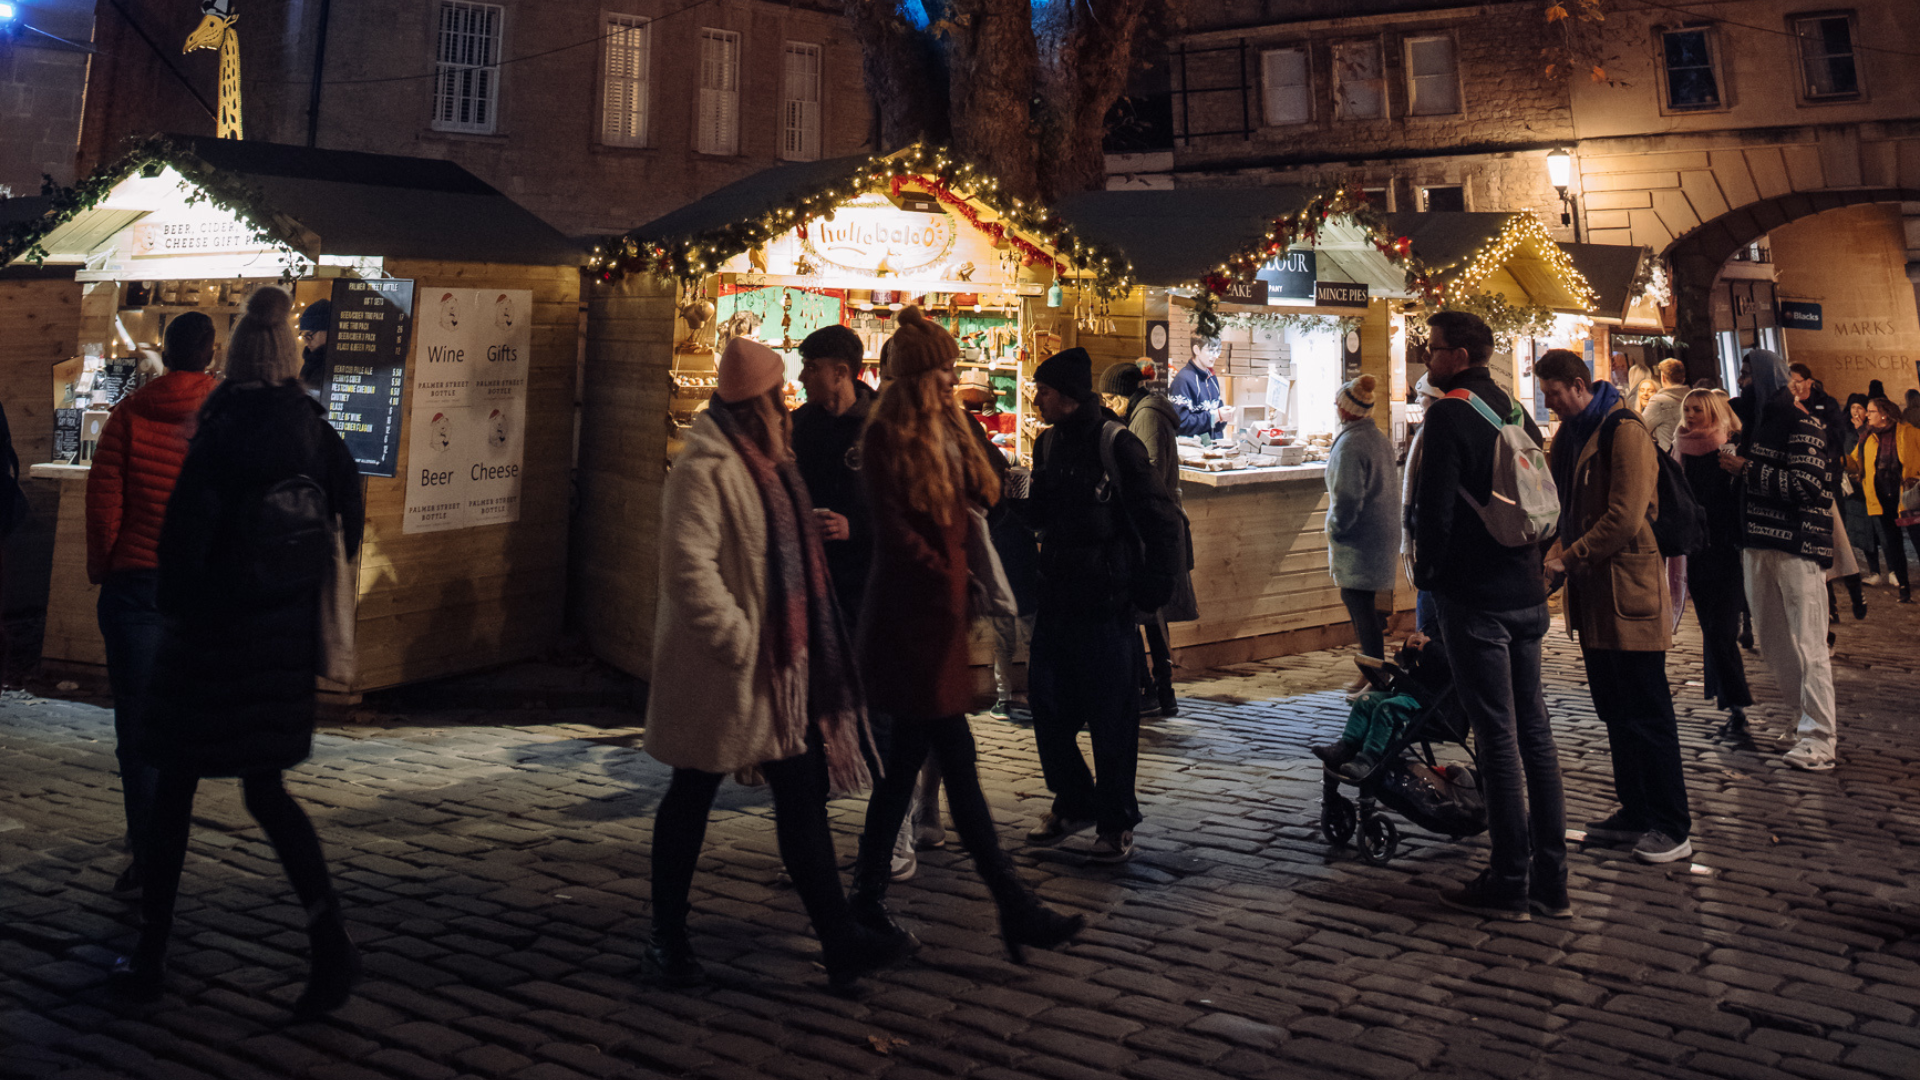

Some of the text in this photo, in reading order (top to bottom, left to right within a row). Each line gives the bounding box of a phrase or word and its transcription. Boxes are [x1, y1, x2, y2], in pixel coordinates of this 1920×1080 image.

[164, 222, 239, 235] BEER, CIDER,
[165, 237, 208, 249] CHEESE
[214, 236, 240, 247] GIFT
[349, 283, 366, 291] PALMER
[1318, 287, 1367, 302] MINCE PIES
[1793, 312, 1819, 321] Blacks
[1834, 321, 1895, 336] MARKS
[428, 345, 464, 363] Wine
[487, 344, 517, 362] Gifts
[1835, 355, 1913, 370] SPENCER
[418, 381, 443, 389] PALMER
[501, 379, 524, 387] STREET
[421, 469, 454, 486] Beer
[471, 462, 519, 481] Cheese
[436, 503, 461, 511] STREET
[469, 496, 517, 507] PALMER STREET
[481, 506, 505, 514] BOTTLE
[422, 513, 447, 521] BOTTLE
